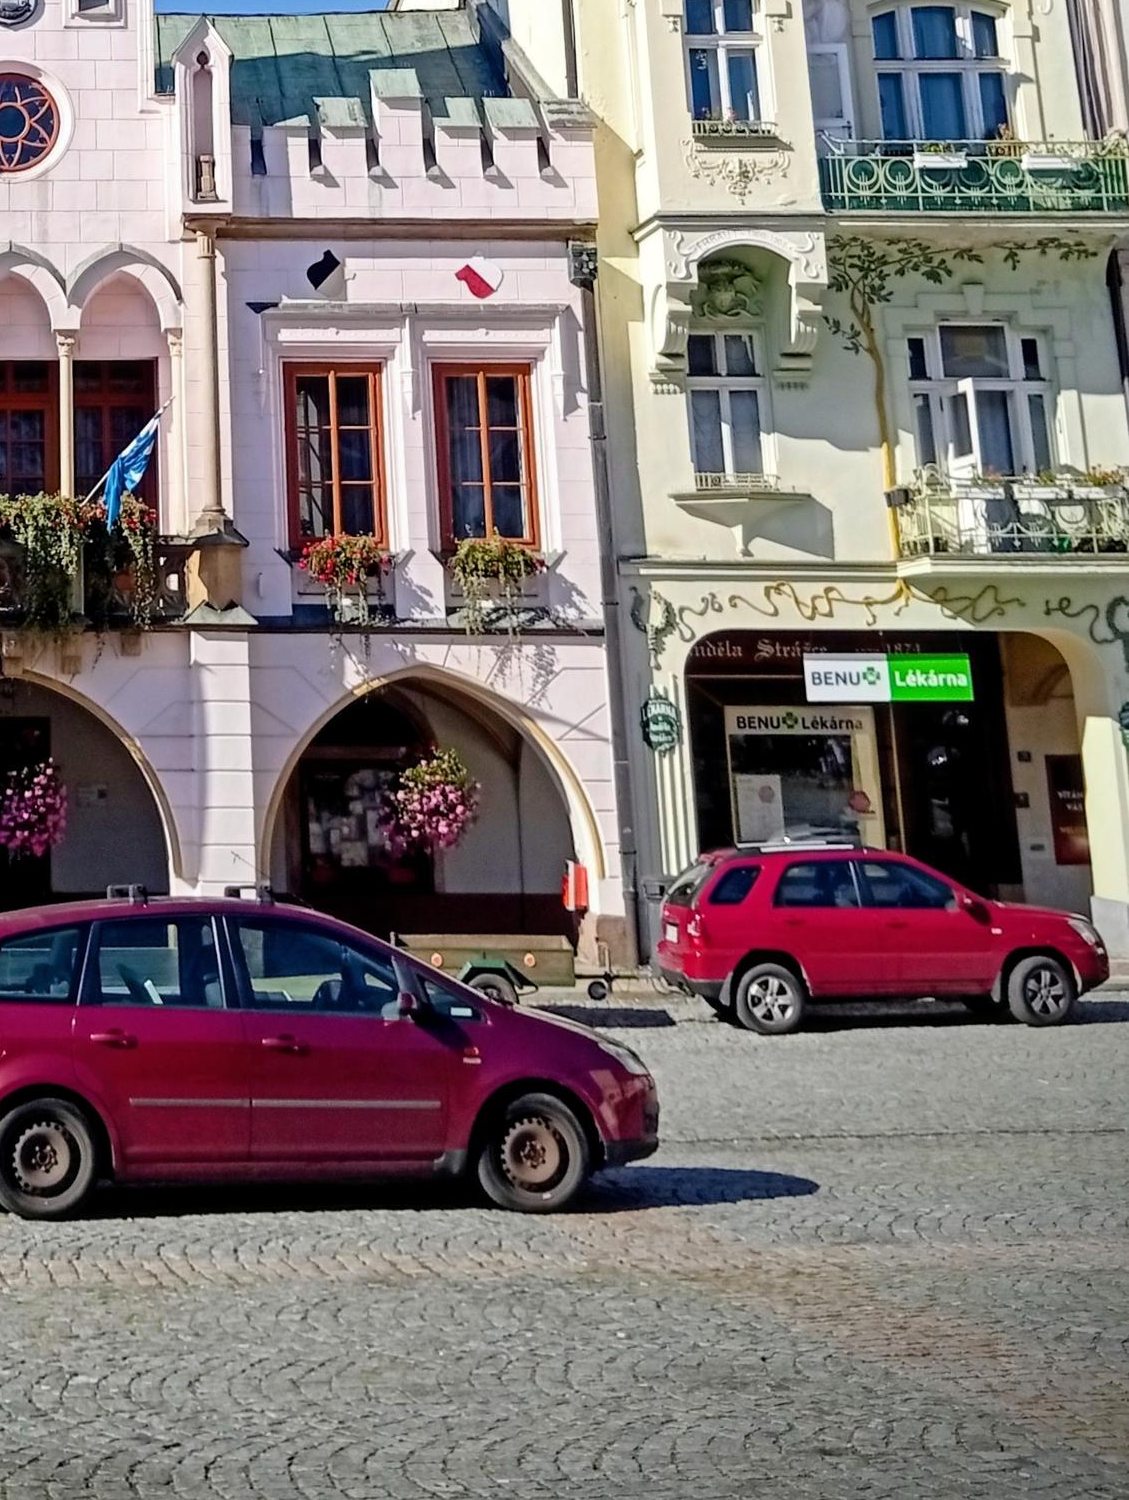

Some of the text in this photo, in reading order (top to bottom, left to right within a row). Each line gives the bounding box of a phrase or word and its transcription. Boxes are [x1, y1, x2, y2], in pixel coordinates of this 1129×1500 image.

[689, 639, 743, 657] nděla
[811, 668, 969, 688] BENU Lékárna
[736, 714, 864, 731] BENU Lékárna
